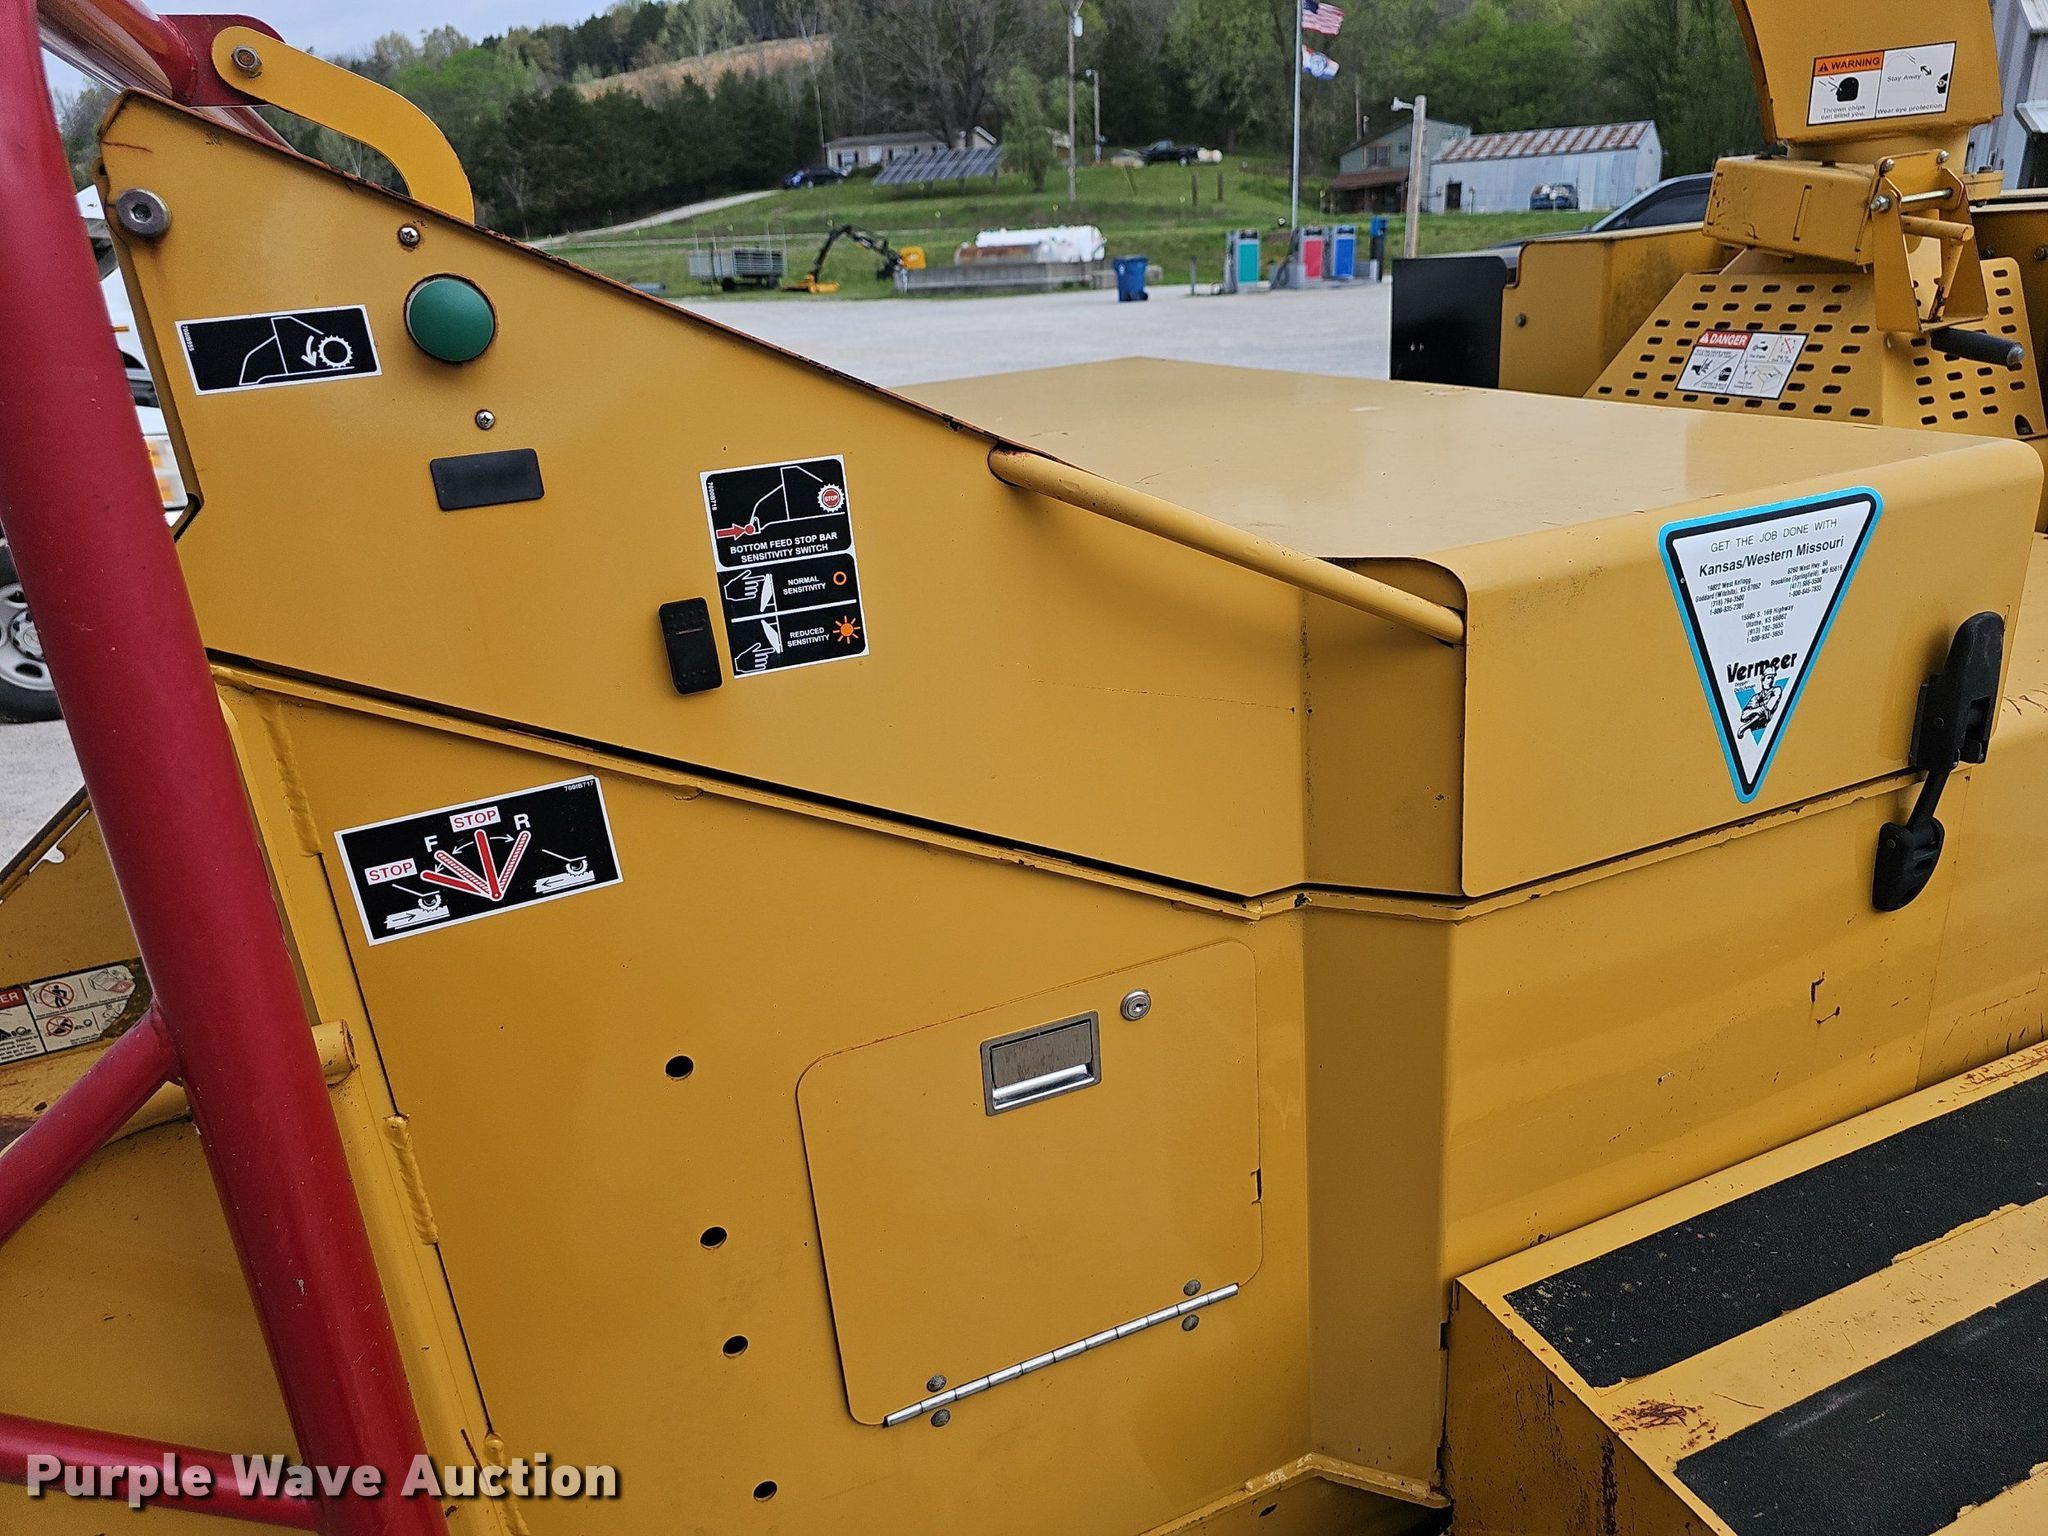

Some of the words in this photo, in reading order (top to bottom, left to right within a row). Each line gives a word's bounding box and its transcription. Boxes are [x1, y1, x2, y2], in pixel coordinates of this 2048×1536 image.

[1831, 57, 1881, 70] WARNING
[1887, 75, 1902, 83] Stay
[1903, 74, 1922, 82] Away
[1848, 105, 1865, 113] chips
[1709, 333, 1748, 346] DANGER
[824, 494, 838, 503] STOP
[1711, 540, 1730, 552] GET
[1736, 535, 1754, 547] THE
[1759, 531, 1777, 543] JOB
[1783, 524, 1809, 537] DONE
[1814, 518, 1837, 531] WITH
[730, 542, 768, 555] BOTTOM
[769, 538, 793, 549] FEED
[795, 535, 818, 546] STOP
[819, 532, 838, 542] BAR
[741, 549, 793, 563] SENSITIVITY
[795, 544, 828, 556] SWITCH
[1699, 549, 1793, 577] Kansas/Western
[1796, 536, 1844, 556] Missouri
[787, 575, 820, 586] NORMAL
[1734, 578, 1751, 586] Kellogg
[1770, 576, 1791, 586] Brookline
[1789, 581, 1801, 590] (417)
[783, 582, 827, 595] SENSITIVITY
[1695, 593, 1714, 602] Goddard
[1773, 605, 1794, 613] Highway
[789, 627, 825, 639] REDUCED
[787, 634, 830, 648] SENSITIVITY
[1726, 652, 1797, 683] Vermeer
[453, 809, 498, 829] STOP
[424, 835, 439, 852] F
[514, 813, 531, 831] R
[368, 861, 413, 882] STOP
